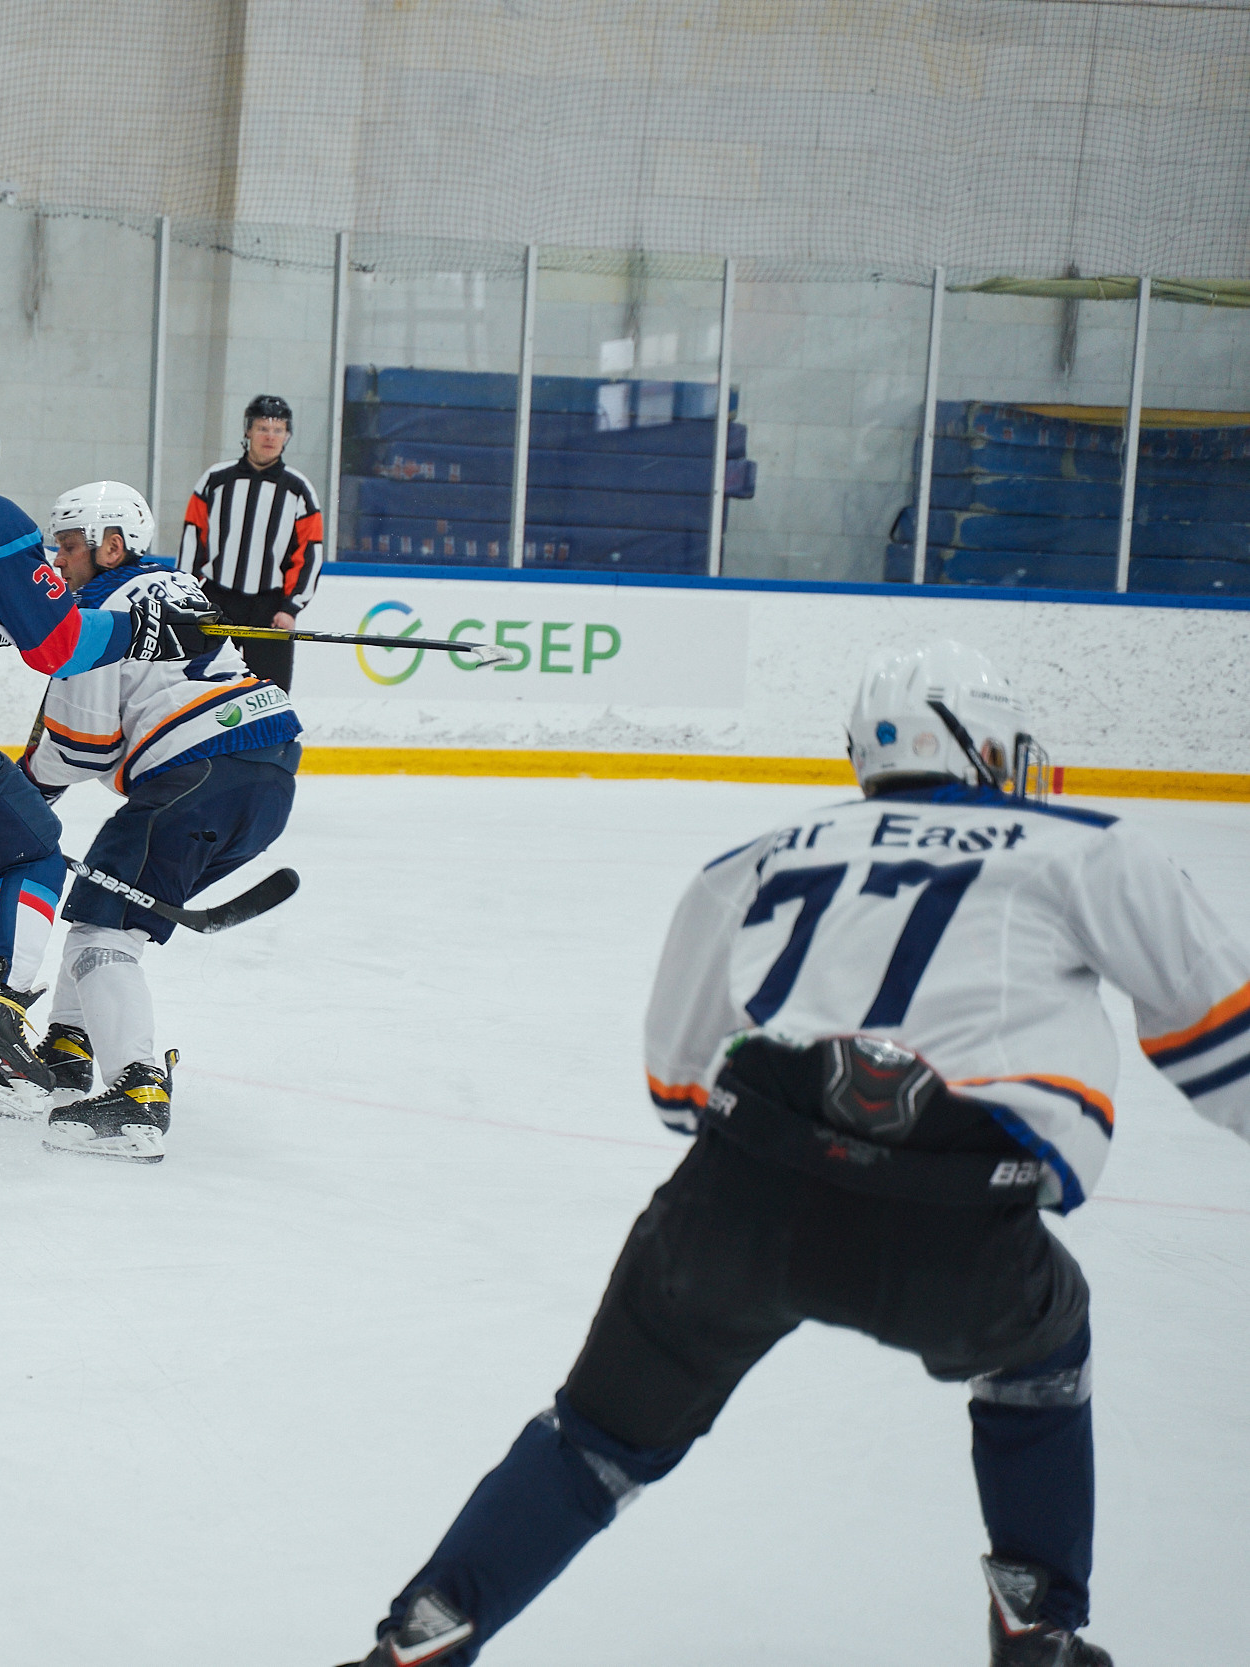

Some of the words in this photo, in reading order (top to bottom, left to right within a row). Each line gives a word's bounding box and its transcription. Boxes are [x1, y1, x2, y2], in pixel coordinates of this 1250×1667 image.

[32, 563, 68, 600] 3
[447, 618, 622, 675] СБЕР
[871, 811, 1026, 853] East
[742, 858, 985, 1030] 77
